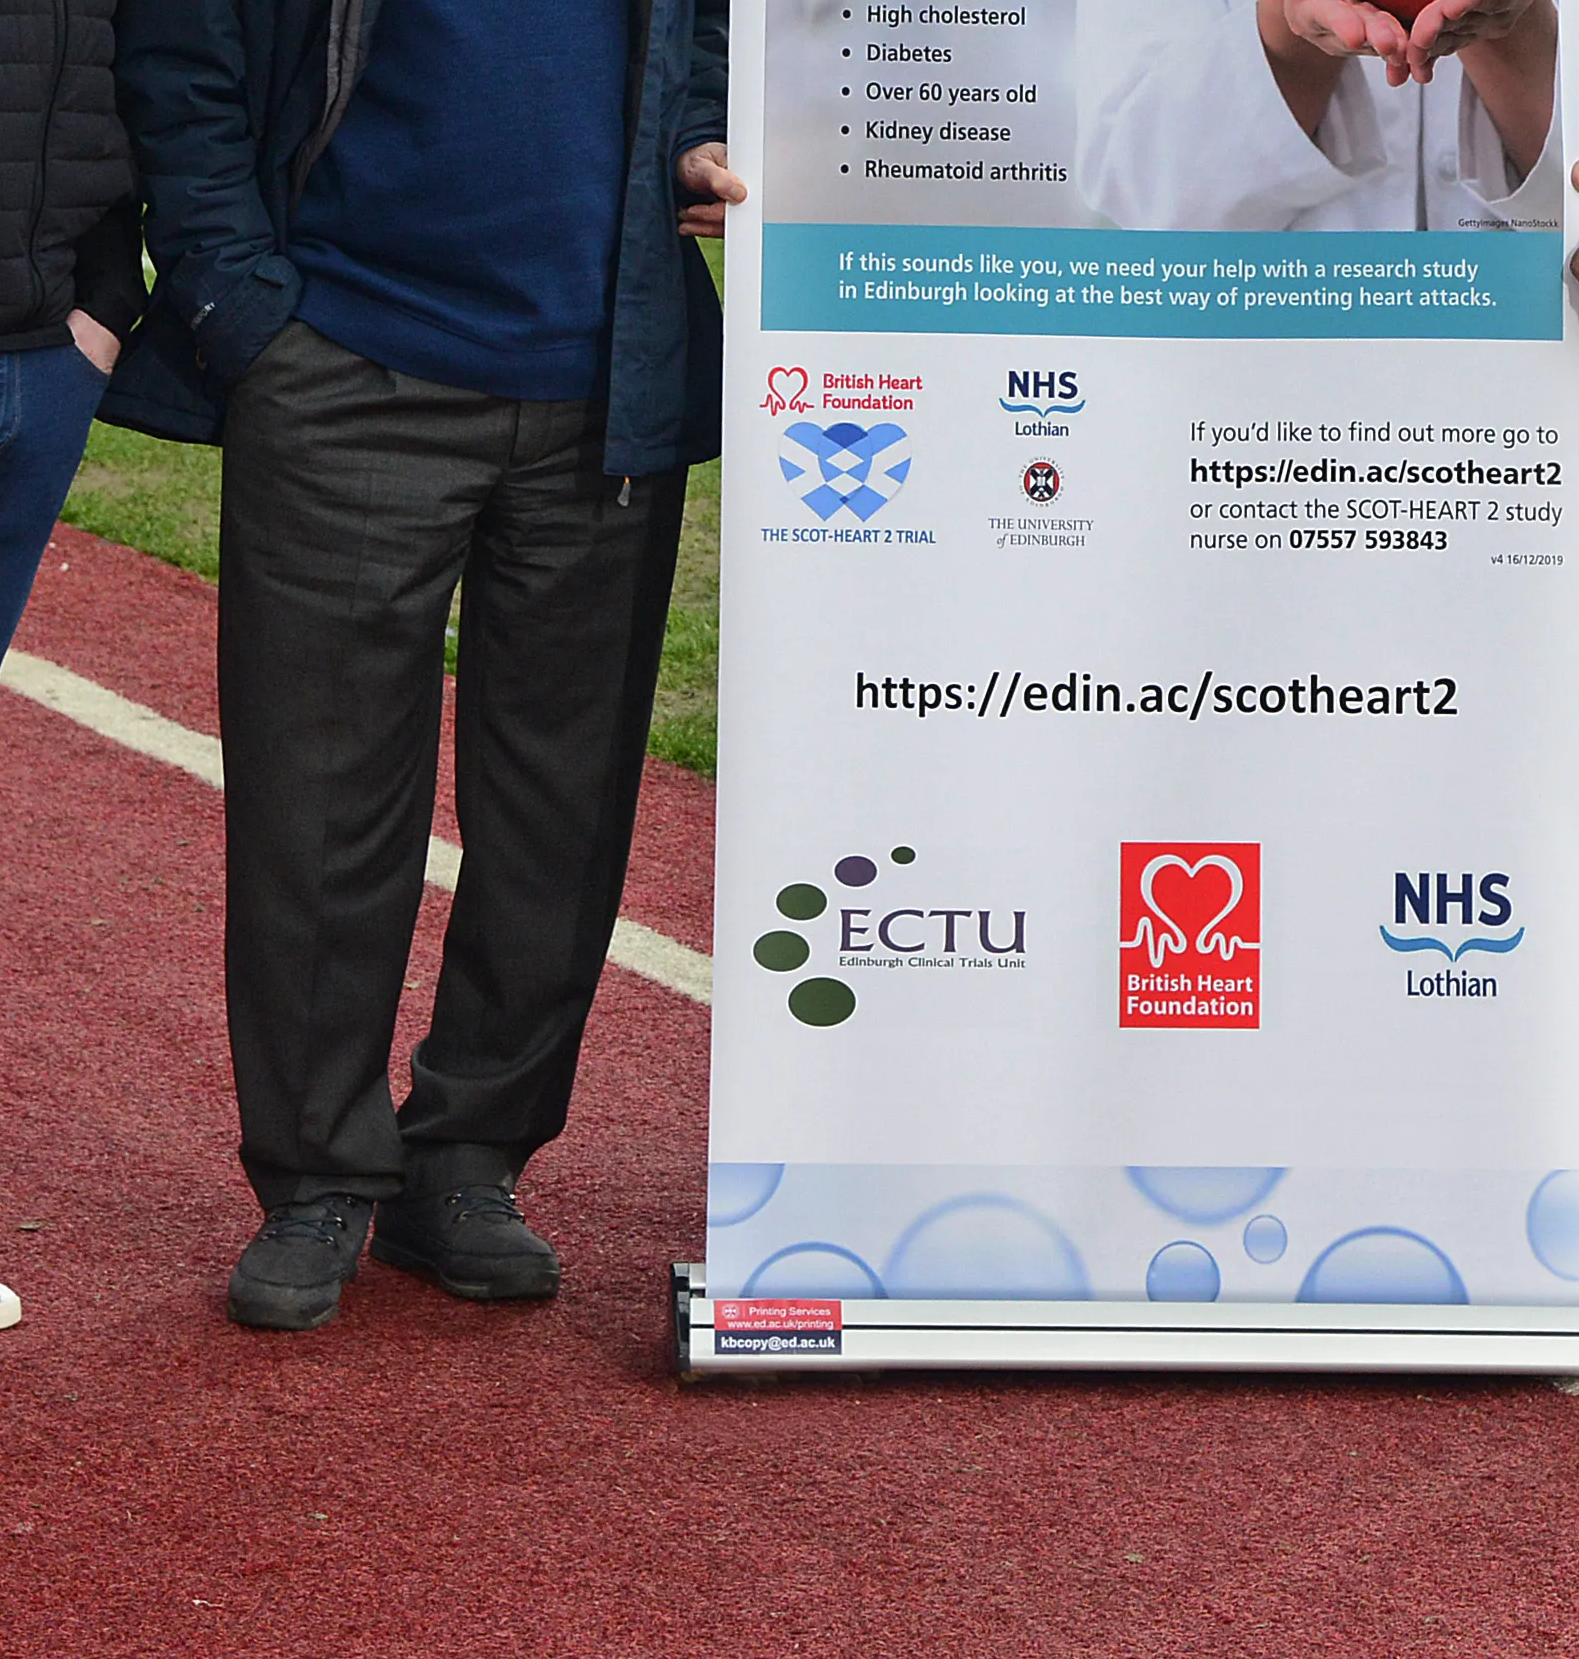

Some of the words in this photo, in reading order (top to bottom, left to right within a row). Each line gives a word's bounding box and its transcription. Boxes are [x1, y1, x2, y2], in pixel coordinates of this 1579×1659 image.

[867, 4, 912, 28] High
[919, 4, 1025, 26] cholesterol
[867, 43, 952, 63] Diabetes
[866, 82, 914, 101] Over
[919, 82, 942, 101] 60
[948, 88, 1000, 107] years
[1006, 84, 1037, 103] old
[866, 120, 934, 145] Kidney
[939, 121, 1011, 142] disease
[865, 159, 983, 180] Rheumatoid
[990, 161, 1067, 182] arthritis
[839, 251, 854, 271] If
[859, 252, 896, 272] this
[902, 253, 974, 273] sounds
[980, 253, 1014, 274] like
[1020, 260, 1063, 279] you,
[1069, 261, 1100, 276] we
[1106, 257, 1155, 277] need
[1161, 263, 1207, 283] your
[1213, 258, 1257, 283] help
[1262, 258, 1308, 278] with
[1314, 264, 1326, 278] a
[1333, 258, 1416, 278] research
[1423, 258, 1479, 283] study
[839, 280, 857, 299] in
[864, 280, 967, 306] Edinburgh
[974, 281, 1049, 308] looking
[1055, 286, 1076, 304] at
[1081, 284, 1114, 304] the
[1120, 285, 1163, 306] best
[1168, 291, 1211, 311] way
[1216, 286, 1239, 306] of
[1244, 287, 1353, 311] preventing
[1359, 286, 1414, 306] heart
[1419, 286, 1497, 307] attacks.
[823, 374, 873, 390] British
[879, 375, 923, 390] Heart
[1008, 370, 1078, 400] NHS
[823, 394, 913, 410] Foundation
[1015, 421, 1069, 437] Lothian
[1191, 420, 1206, 442] If
[1277, 421, 1312, 442] like
[1318, 424, 1342, 442] to
[1348, 421, 1391, 442] find
[1398, 424, 1435, 443] out
[1442, 427, 1496, 444] more
[1502, 428, 1530, 449] go
[1536, 426, 1559, 445] to
[1191, 458, 1562, 489] https://edin.ac/scotheart2
[1190, 503, 1213, 519] or
[1219, 501, 1298, 519] contact
[1304, 498, 1340, 519] the
[1346, 499, 1481, 520] SCOT-HEART
[1487, 501, 1499, 521] 2
[1506, 501, 1563, 527] study
[988, 518, 1013, 530] THE
[1017, 518, 1092, 531] UNIVERSITY
[761, 528, 788, 542] THE
[792, 528, 881, 543] SCOT-HEART
[884, 529, 892, 544] 2
[895, 529, 936, 544] TRIAL
[996, 533, 1009, 549] of
[1010, 534, 1085, 547] EDINBURGH
[1190, 534, 1248, 549] nurse
[1255, 534, 1282, 549] on
[1289, 529, 1357, 549] 07557
[1365, 530, 1447, 551] 593843
[1490, 554, 1504, 565] v4
[1507, 554, 1564, 566] 16/12/2019
[856, 671, 1458, 721] https://edin.ac/scotheart2
[1395, 872, 1512, 927] NHS
[838, 909, 1025, 954] ECTU
[839, 956, 904, 969] Edinburgh
[907, 956, 955, 968] Clinical
[959, 957, 993, 968] Trials
[997, 958, 1025, 969] Unit
[1127, 973, 1192, 992] British
[1197, 974, 1253, 993] Heart
[1407, 969, 1497, 997] Lothian
[1127, 995, 1253, 1016] Foundation
[749, 1307, 786, 1317] Printing
[789, 1307, 831, 1316] Services
[727, 1319, 834, 1330] www.ed.ac.uk/printing
[721, 1336, 835, 1350] kbcopy@ed.ac.uk
